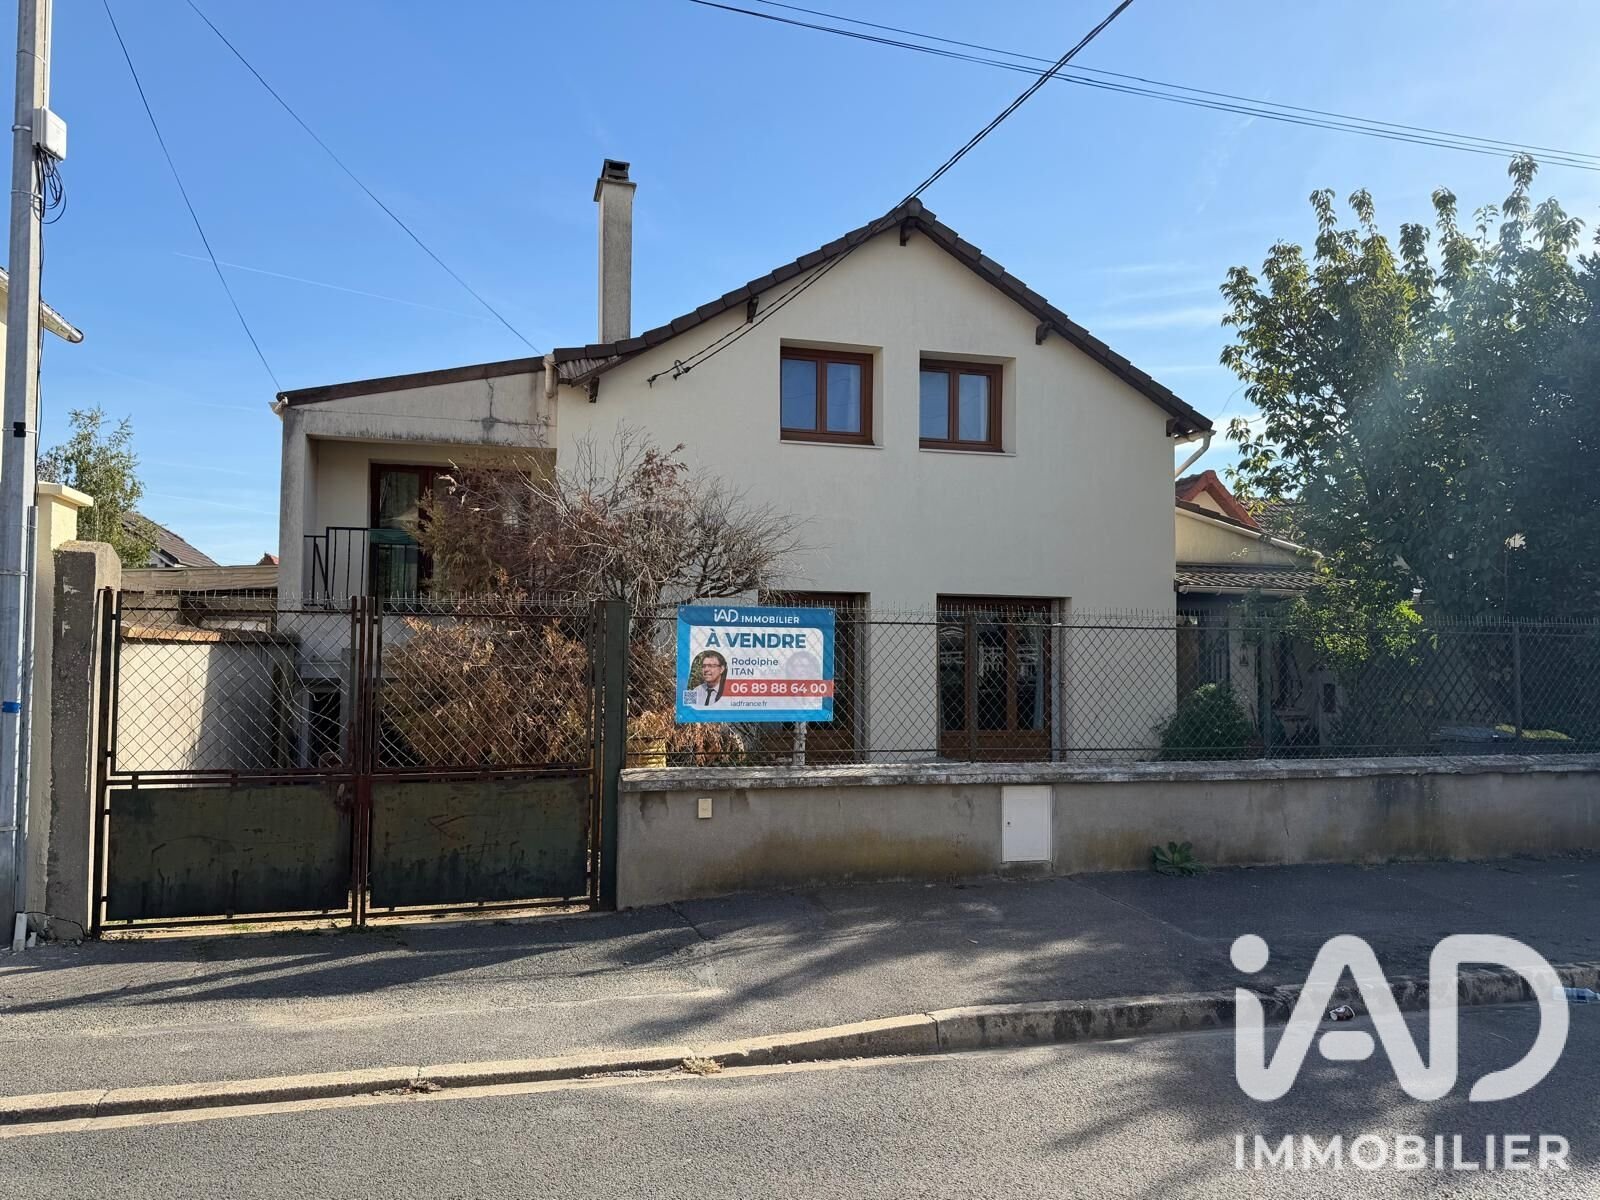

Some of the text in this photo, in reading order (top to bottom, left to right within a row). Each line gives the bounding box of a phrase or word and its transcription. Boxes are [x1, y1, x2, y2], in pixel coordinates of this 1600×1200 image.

[742, 616, 799, 624] IMMOBILIER
[705, 629, 806, 648] À VENDRE
[732, 658, 778, 668] Rodolphe
[732, 668, 754, 676] ITAN
[731, 685, 827, 693] 06 89 88 64 00
